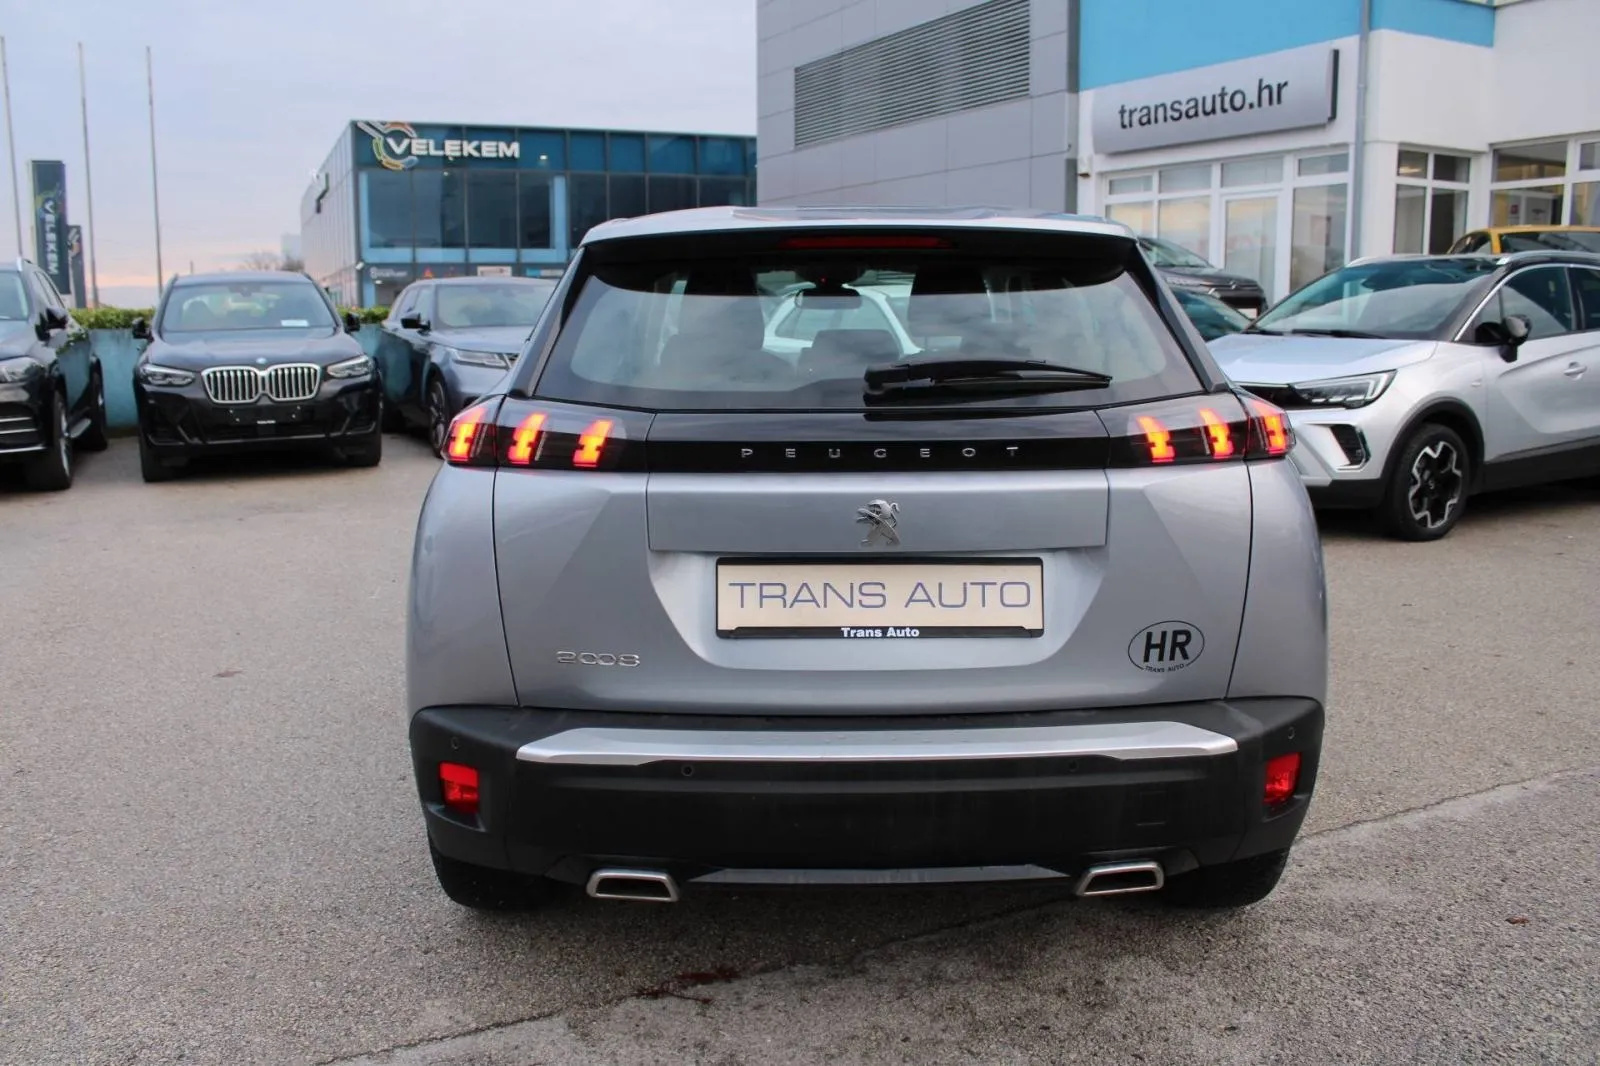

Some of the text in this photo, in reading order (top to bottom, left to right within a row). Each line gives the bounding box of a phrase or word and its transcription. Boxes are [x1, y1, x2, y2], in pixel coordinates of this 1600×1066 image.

[1118, 78, 1288, 129] transauto.hr
[386, 137, 520, 158] VELEKEM
[44, 200, 59, 275] VELEKEM
[741, 446, 1018, 458] PEUGEOT
[728, 581, 1031, 608] TRANS AUTO
[841, 626, 920, 638] Trans Auto
[1143, 629, 1192, 662] HR
[556, 651, 640, 667] 2008
